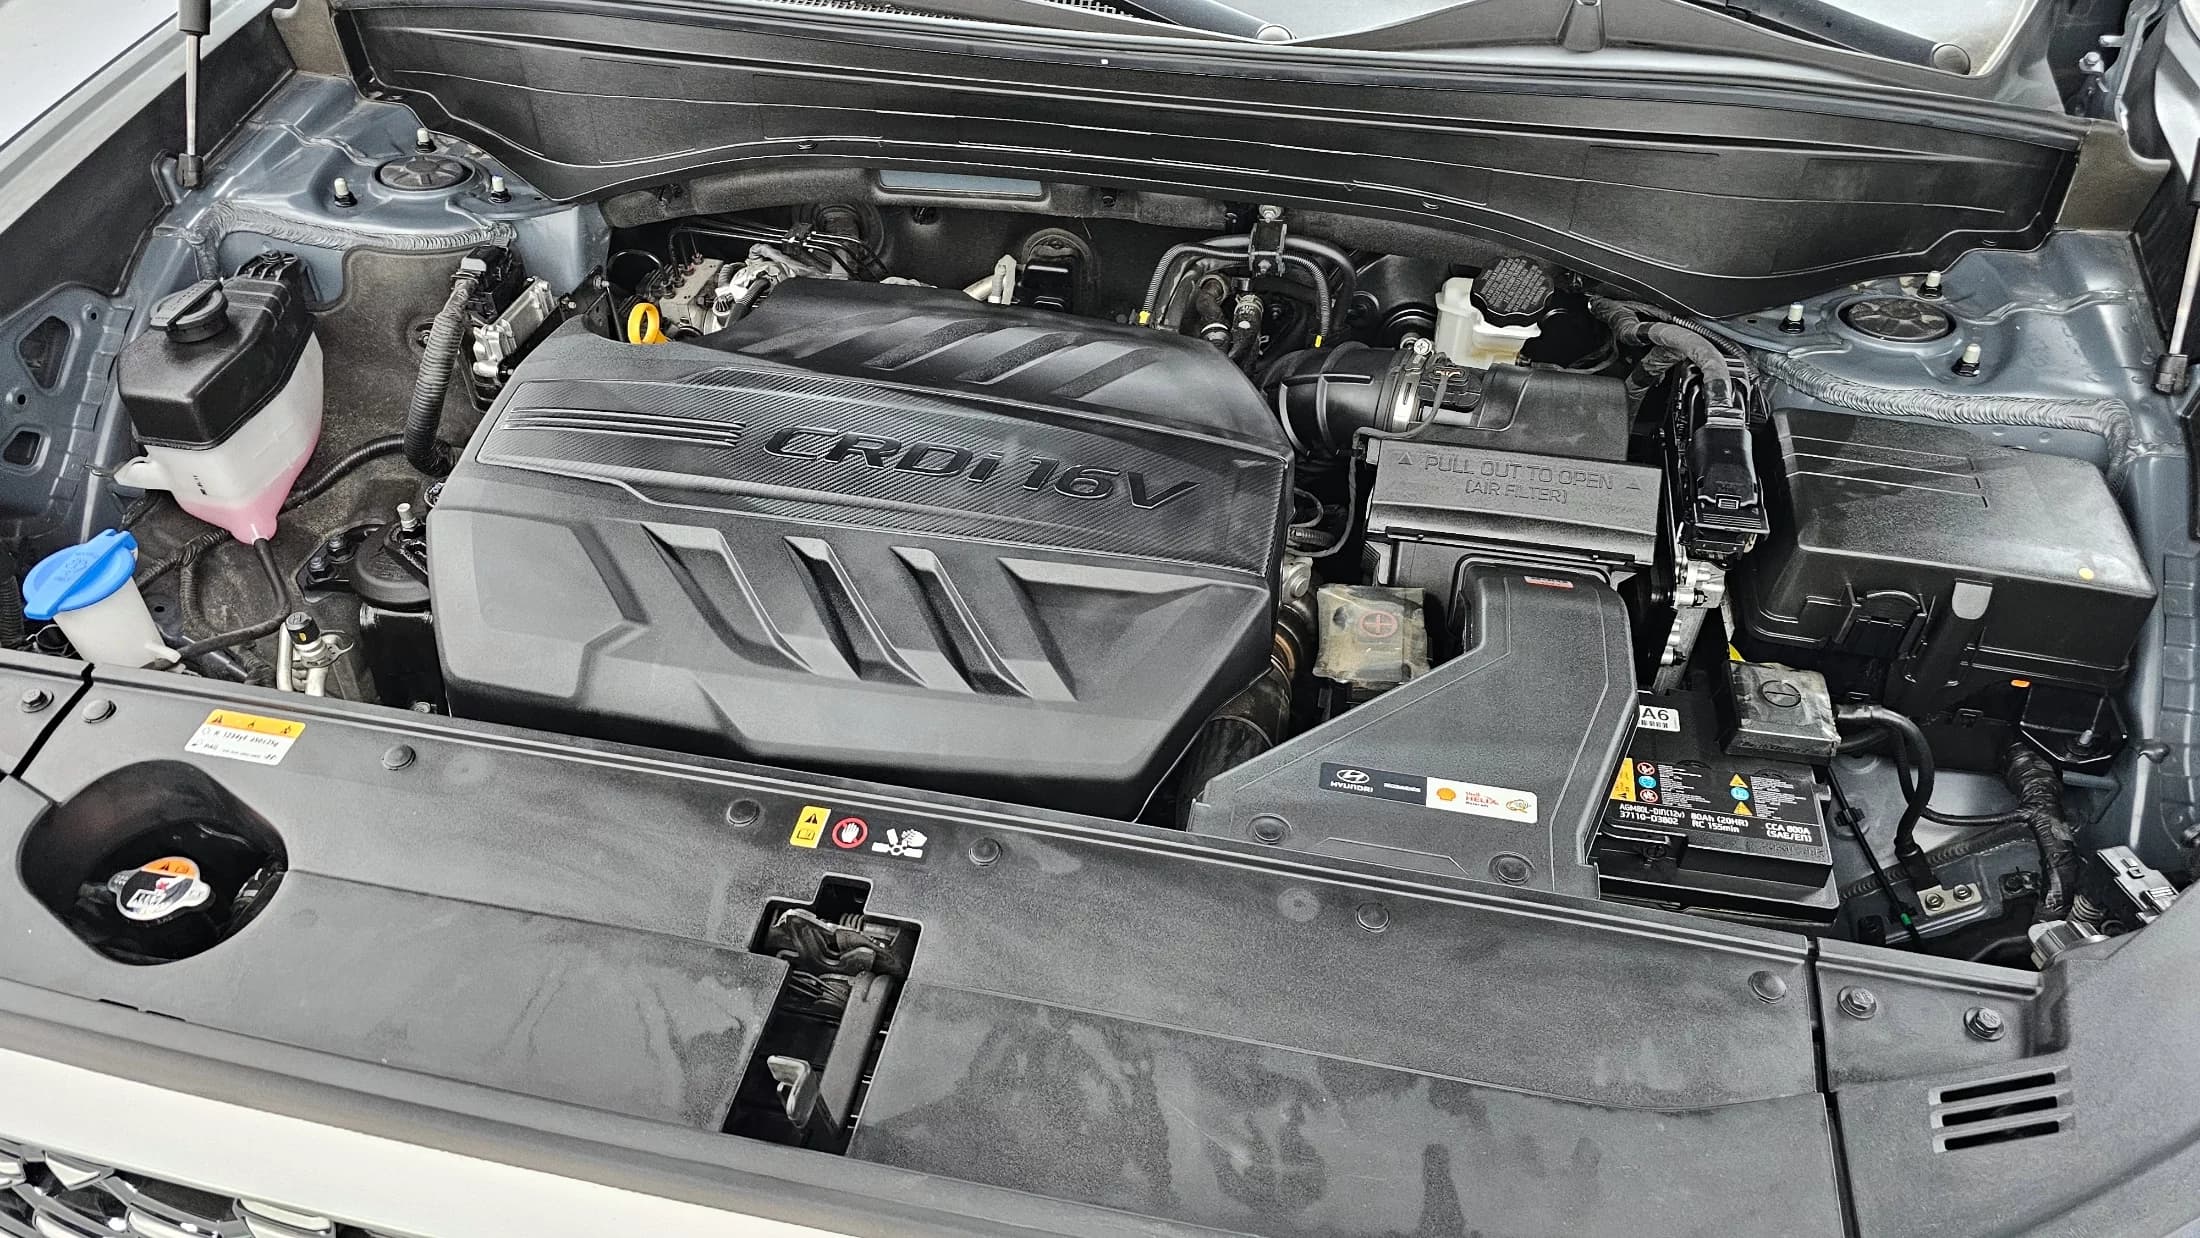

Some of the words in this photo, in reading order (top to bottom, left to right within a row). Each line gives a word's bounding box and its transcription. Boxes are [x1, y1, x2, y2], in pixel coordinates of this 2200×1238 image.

[763, 426, 1002, 484] CRDi
[1022, 455, 1201, 510] 16V
[1424, 455, 1475, 475] PULL
[1480, 460, 1522, 480] OUT
[1526, 465, 1553, 483] TO
[1558, 469, 1614, 490] OPEN
[1641, 707, 1669, 721] A6
[1330, 781, 1374, 793] HYUNDAI
[1692, 819, 1705, 829] RC
[1765, 822, 1785, 832] CCA
